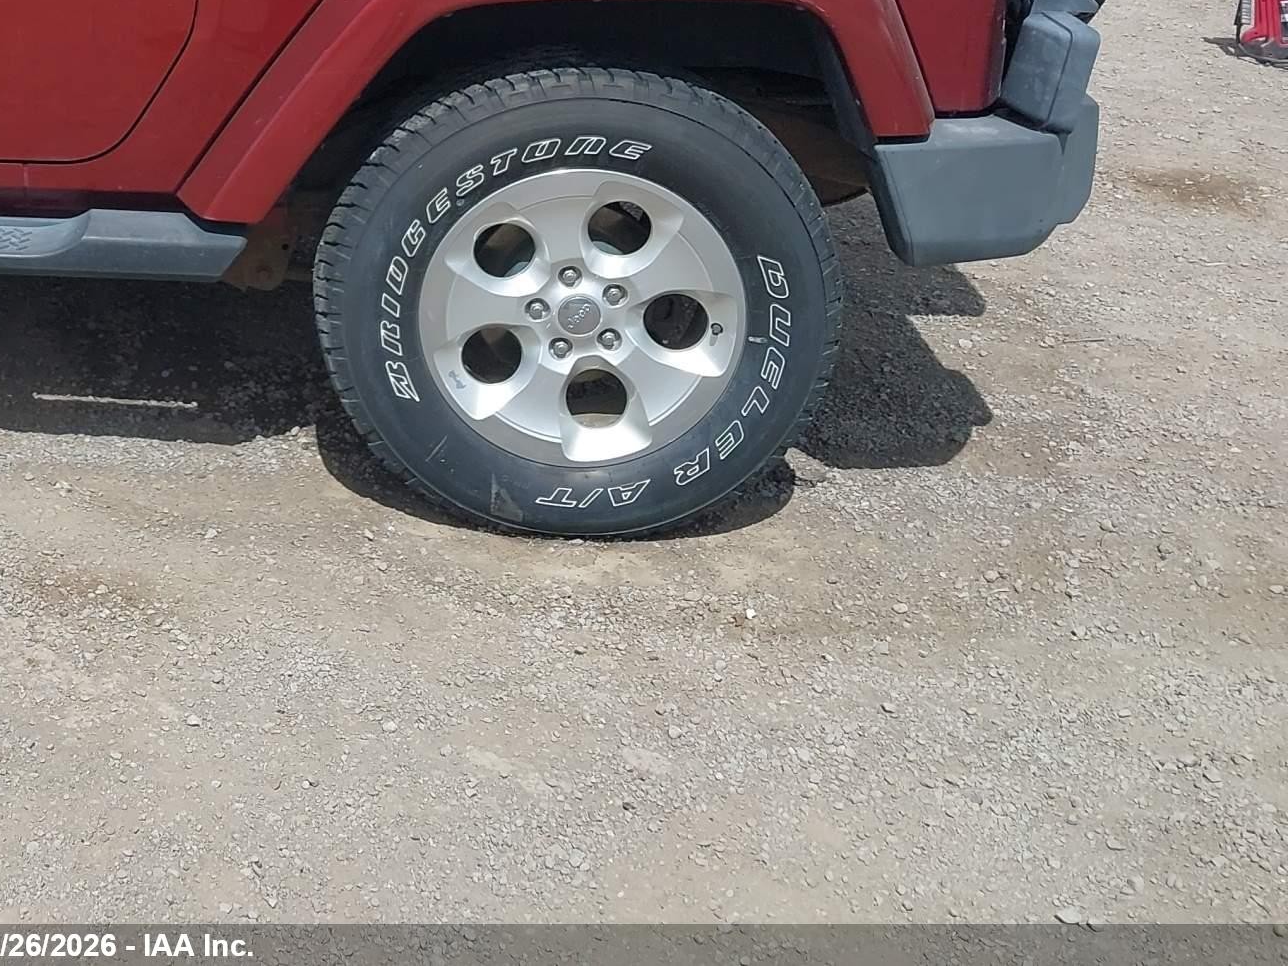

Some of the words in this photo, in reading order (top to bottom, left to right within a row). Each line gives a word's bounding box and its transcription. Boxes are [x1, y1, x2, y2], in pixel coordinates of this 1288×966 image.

[380, 136, 652, 402] BRIDGESTONE
[673, 255, 791, 486] DUELER
[536, 479, 651, 508] A/T
